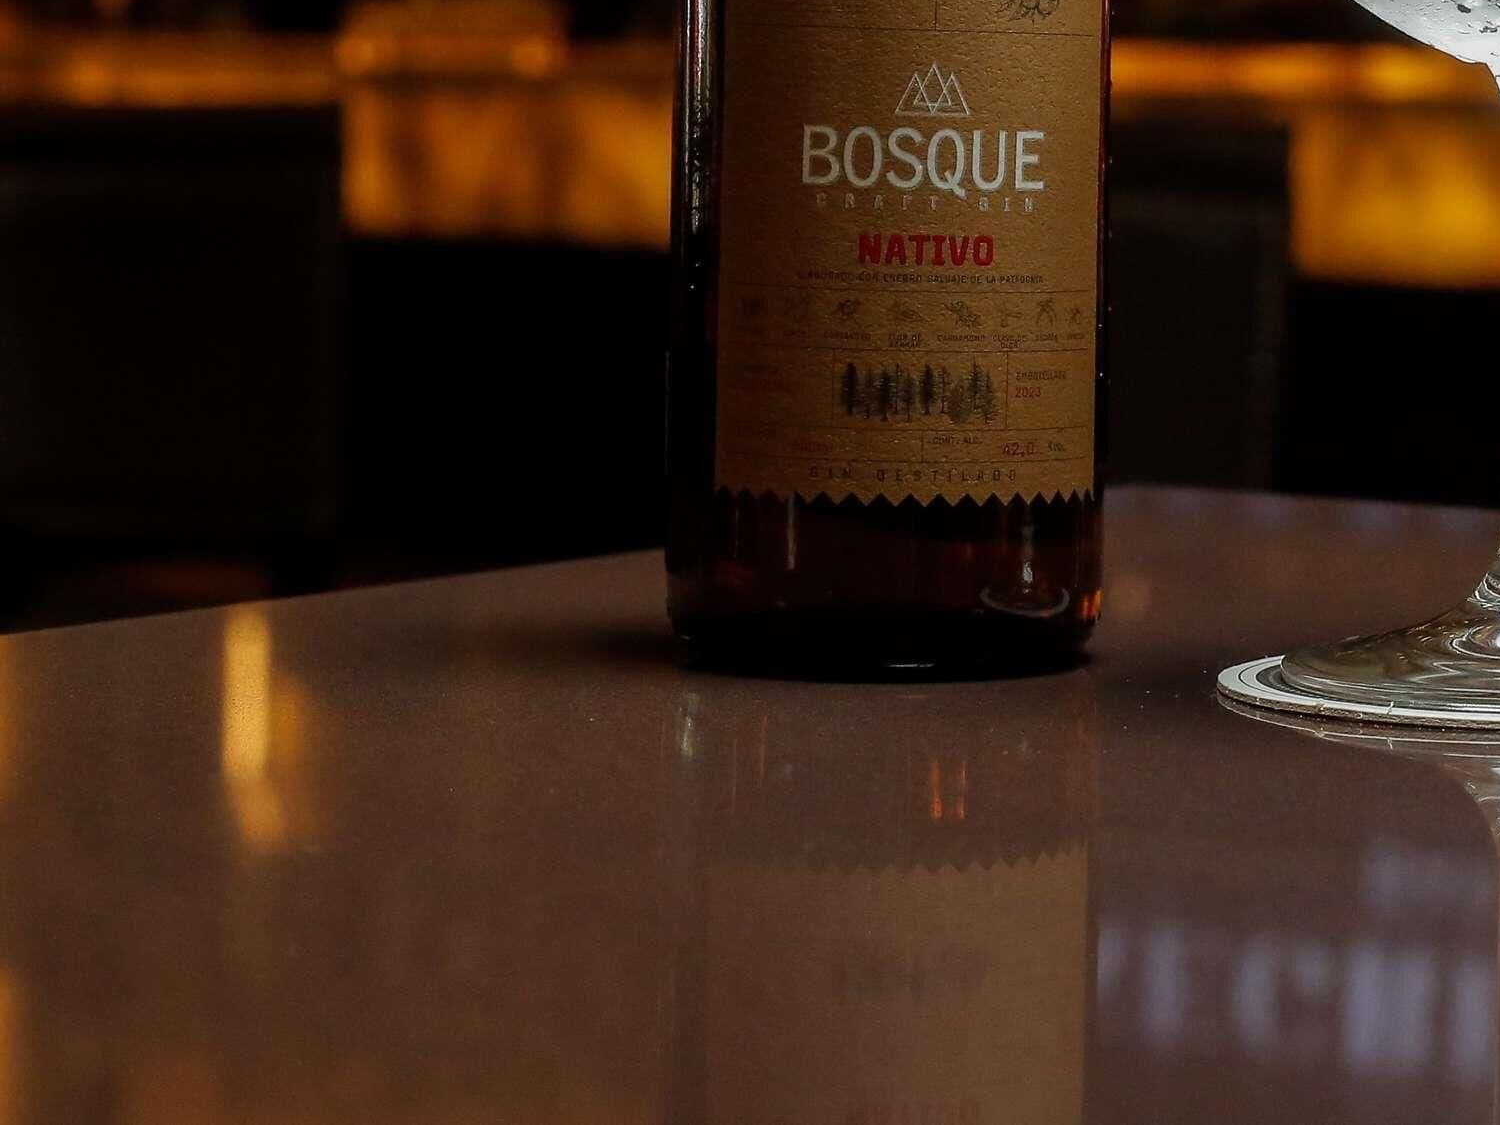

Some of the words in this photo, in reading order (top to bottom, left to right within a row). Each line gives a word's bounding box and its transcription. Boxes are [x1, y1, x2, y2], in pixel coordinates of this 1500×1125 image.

[801, 123, 1046, 200] BOSQUE
[815, 193, 944, 213] CRAFT
[977, 196, 1037, 213] GIN
[857, 233, 994, 267] NATIVO
